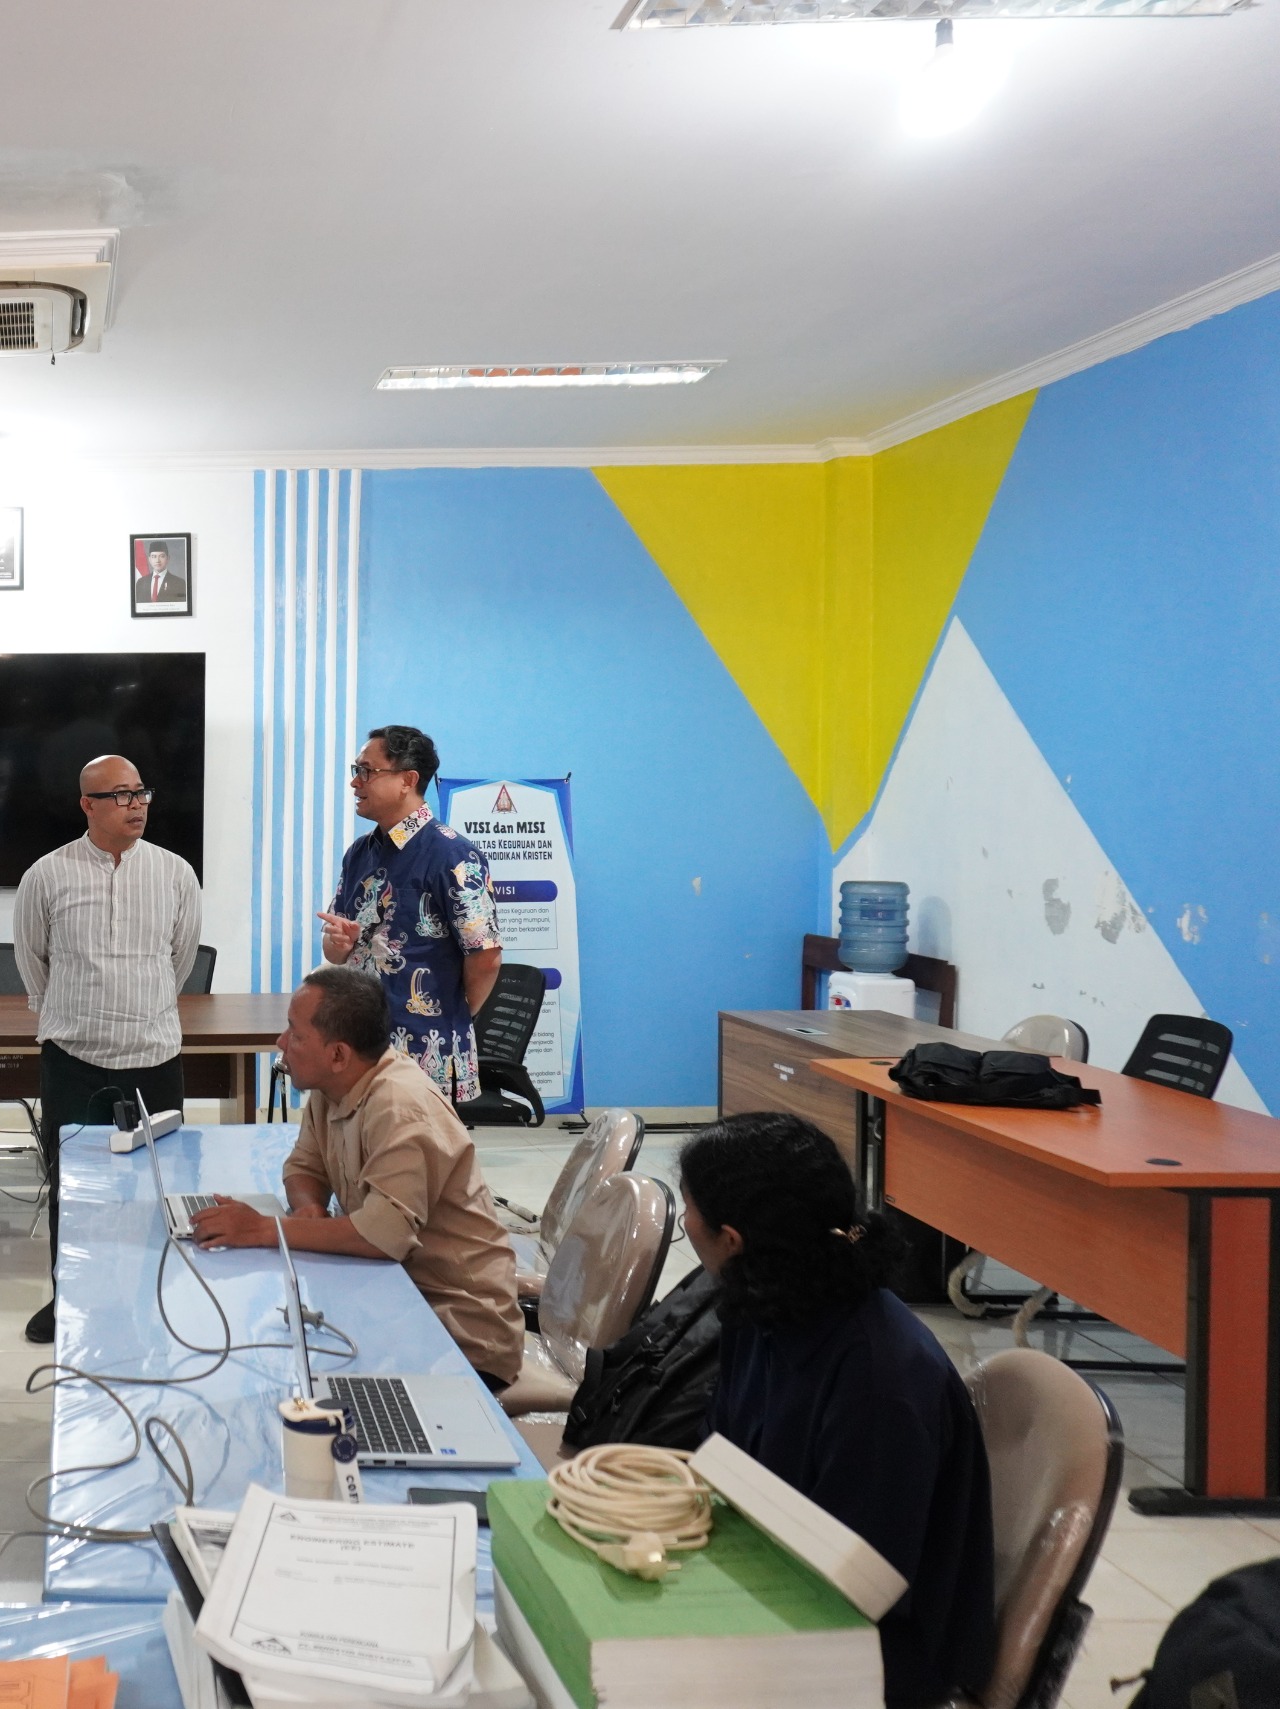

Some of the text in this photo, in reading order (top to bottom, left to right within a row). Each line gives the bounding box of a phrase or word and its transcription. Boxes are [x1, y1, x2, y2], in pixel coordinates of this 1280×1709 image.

[464, 822, 546, 834] VISI dan MISI
[471, 839, 552, 849] ULTAS KEGURUAN DAN
[483, 850, 553, 861] ENDIDIKAN KRISTEN
[495, 886, 516, 895] VISI
[290, 1533, 416, 1549] ENGINEERING ESTIMATE
